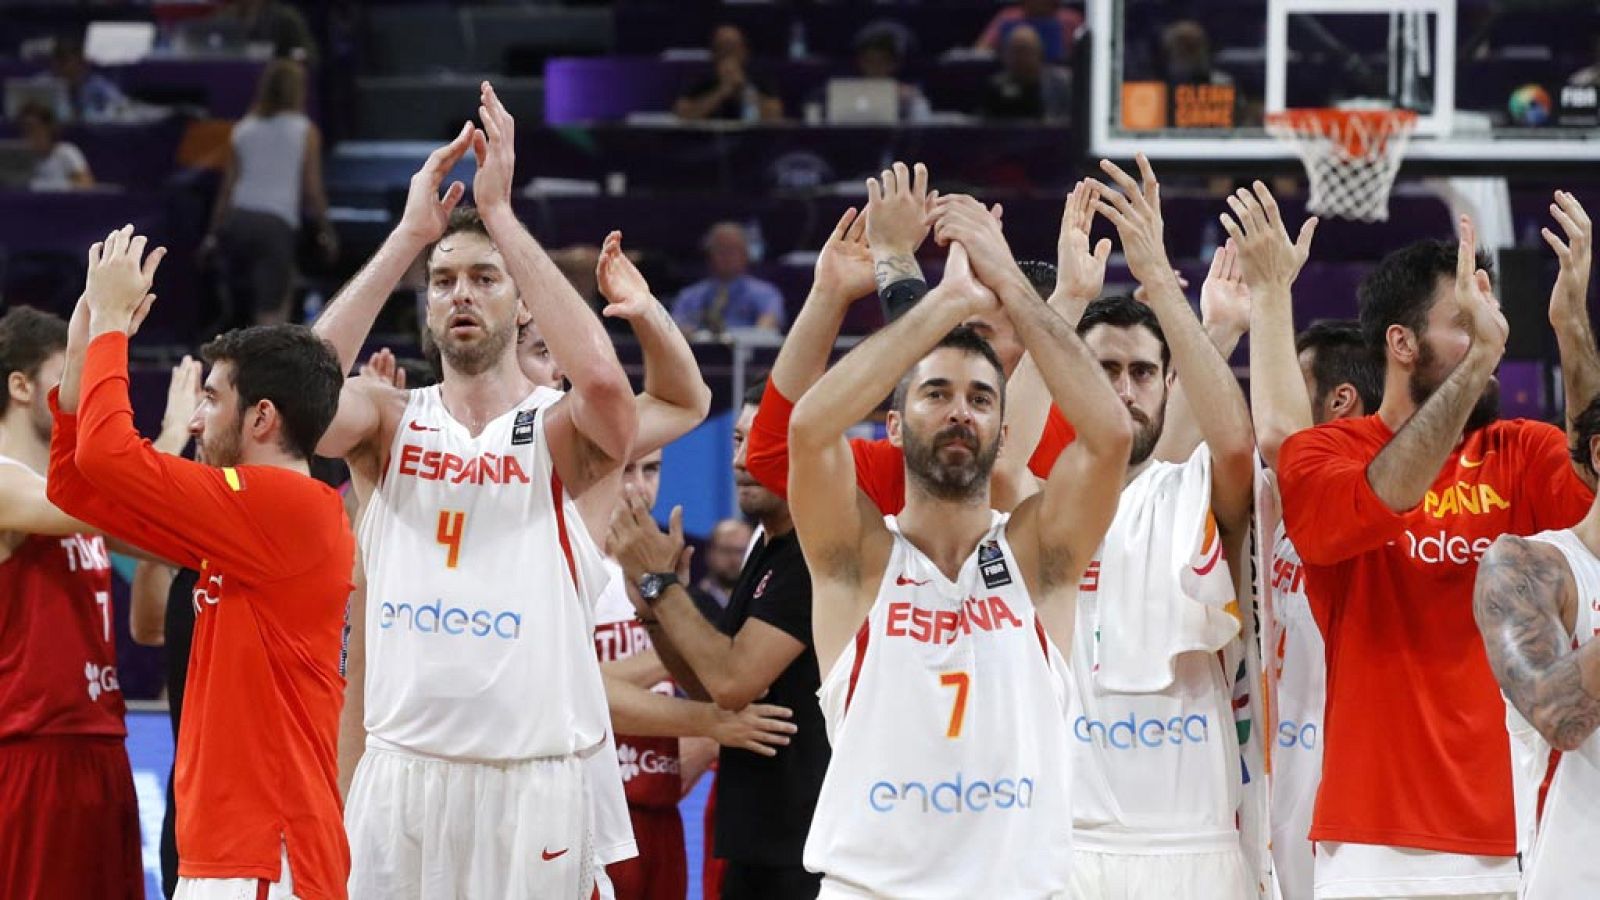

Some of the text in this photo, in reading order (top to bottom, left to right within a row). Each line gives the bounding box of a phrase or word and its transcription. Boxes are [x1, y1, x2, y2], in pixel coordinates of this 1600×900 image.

[399, 444, 530, 485] ESPAÑA
[436, 510, 465, 570] 4
[380, 598, 521, 639] endesa
[940, 672, 970, 739] 7
[869, 772, 1034, 813] endesa
